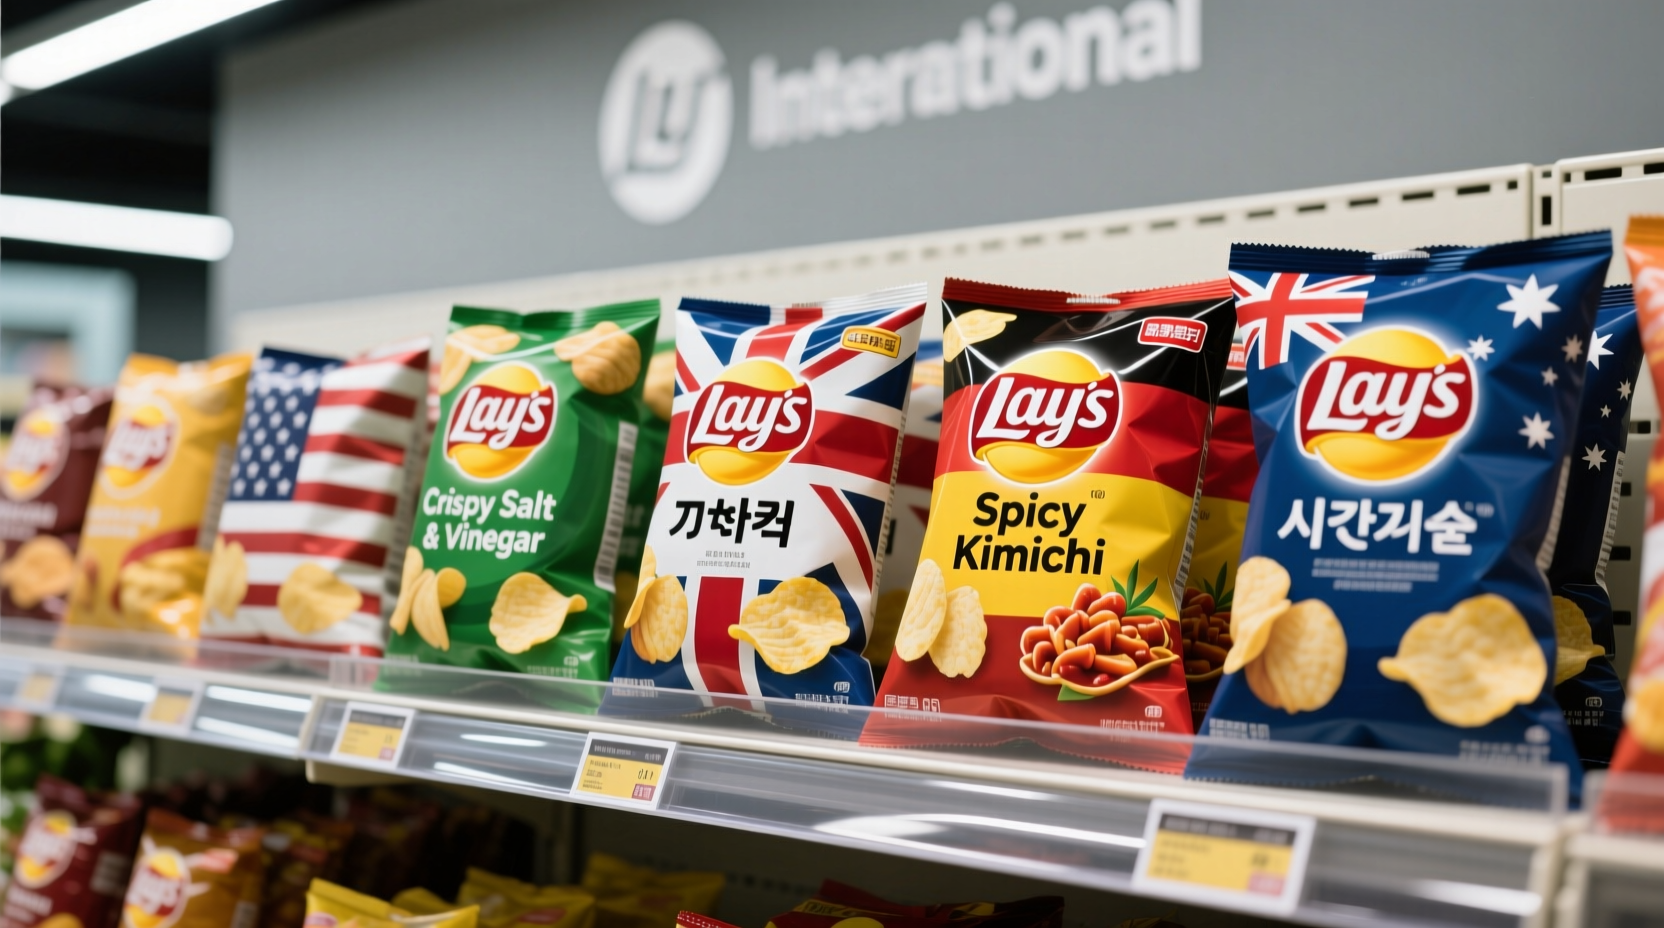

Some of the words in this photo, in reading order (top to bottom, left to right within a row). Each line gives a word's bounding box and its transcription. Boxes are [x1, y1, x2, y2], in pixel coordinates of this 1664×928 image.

[448, 385, 552, 451] Lay's
[690, 384, 808, 452] Lay's
[975, 376, 1114, 448] Lay's
[1307, 360, 1467, 441] Lay's
[422, 486, 495, 525] Crispy
[499, 488, 556, 521] Salt
[973, 492, 1087, 537] Spicy
[422, 521, 440, 550] &
[444, 522, 546, 560] Vinegar
[953, 534, 1106, 575] Kimichi
